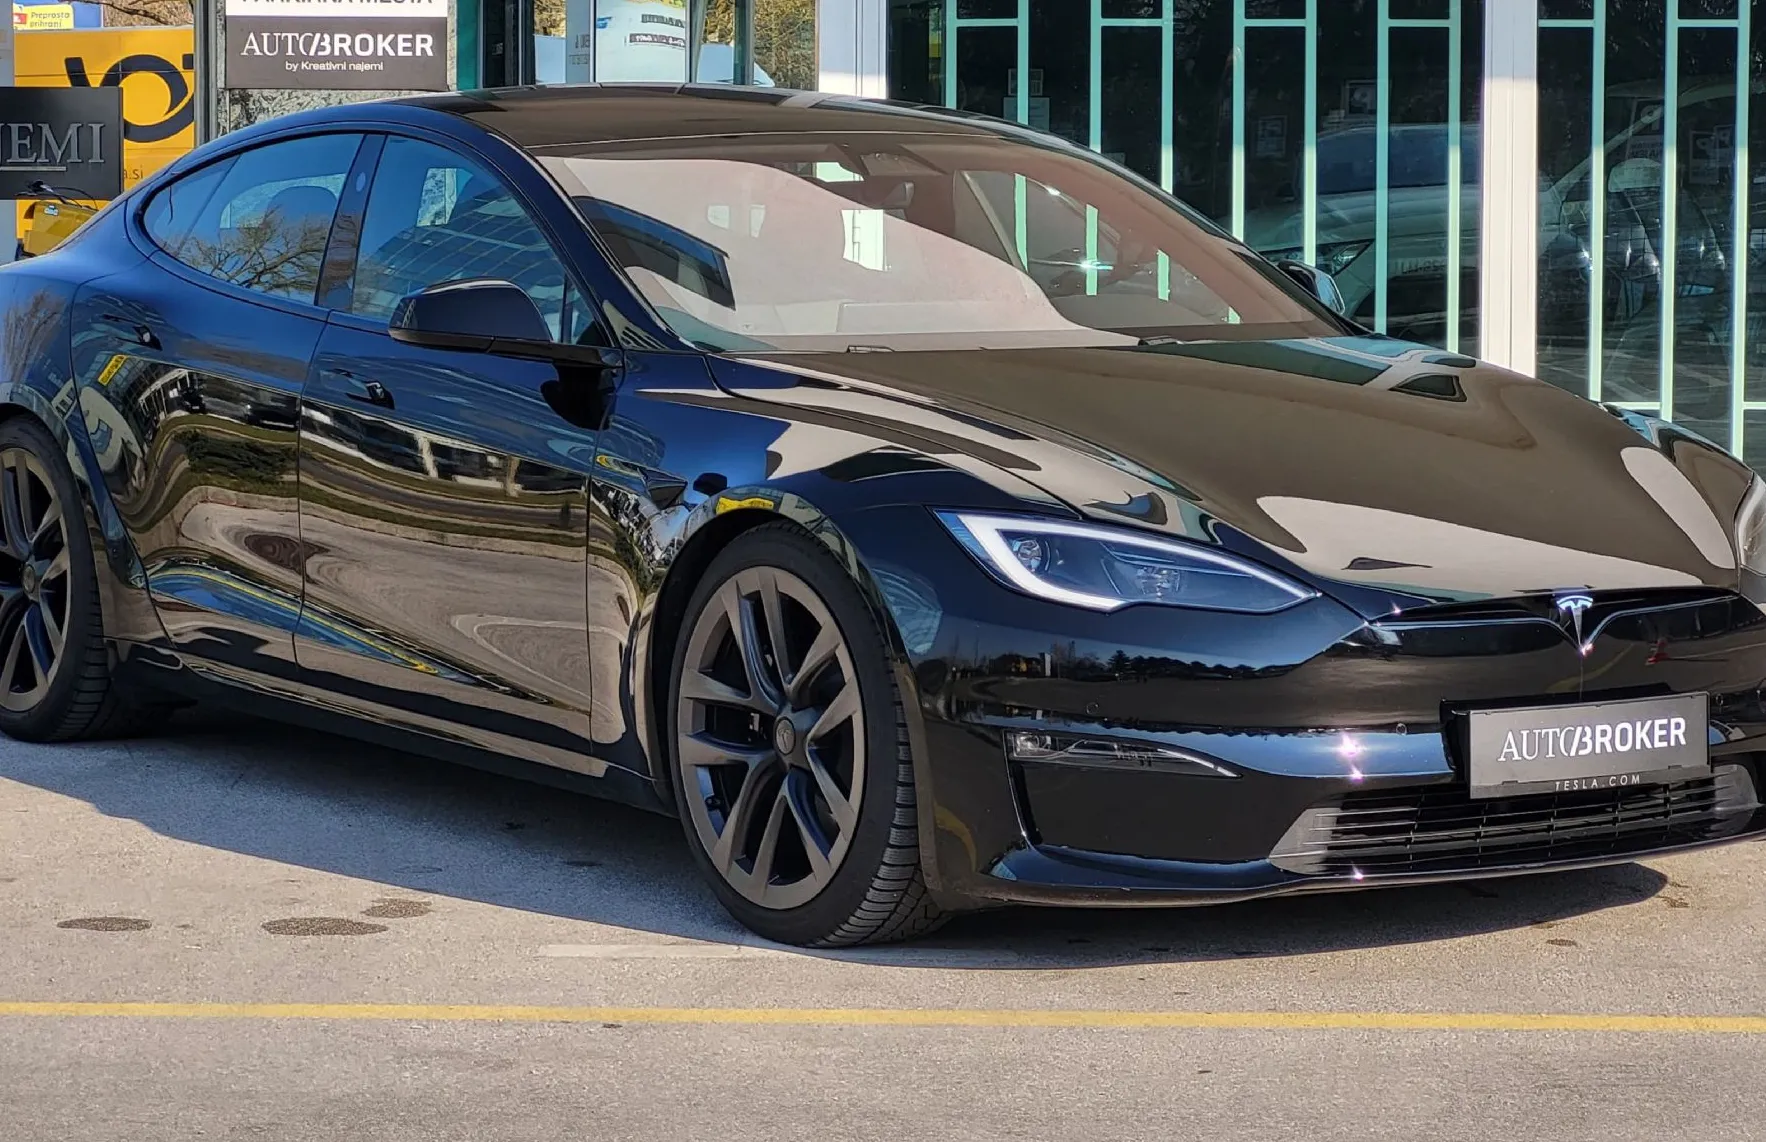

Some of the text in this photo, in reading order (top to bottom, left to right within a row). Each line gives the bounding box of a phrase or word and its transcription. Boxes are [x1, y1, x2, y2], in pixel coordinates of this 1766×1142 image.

[285, 61, 384, 72] by Kreativni najemi
[1555, 774, 1641, 791] TESLA.COM
